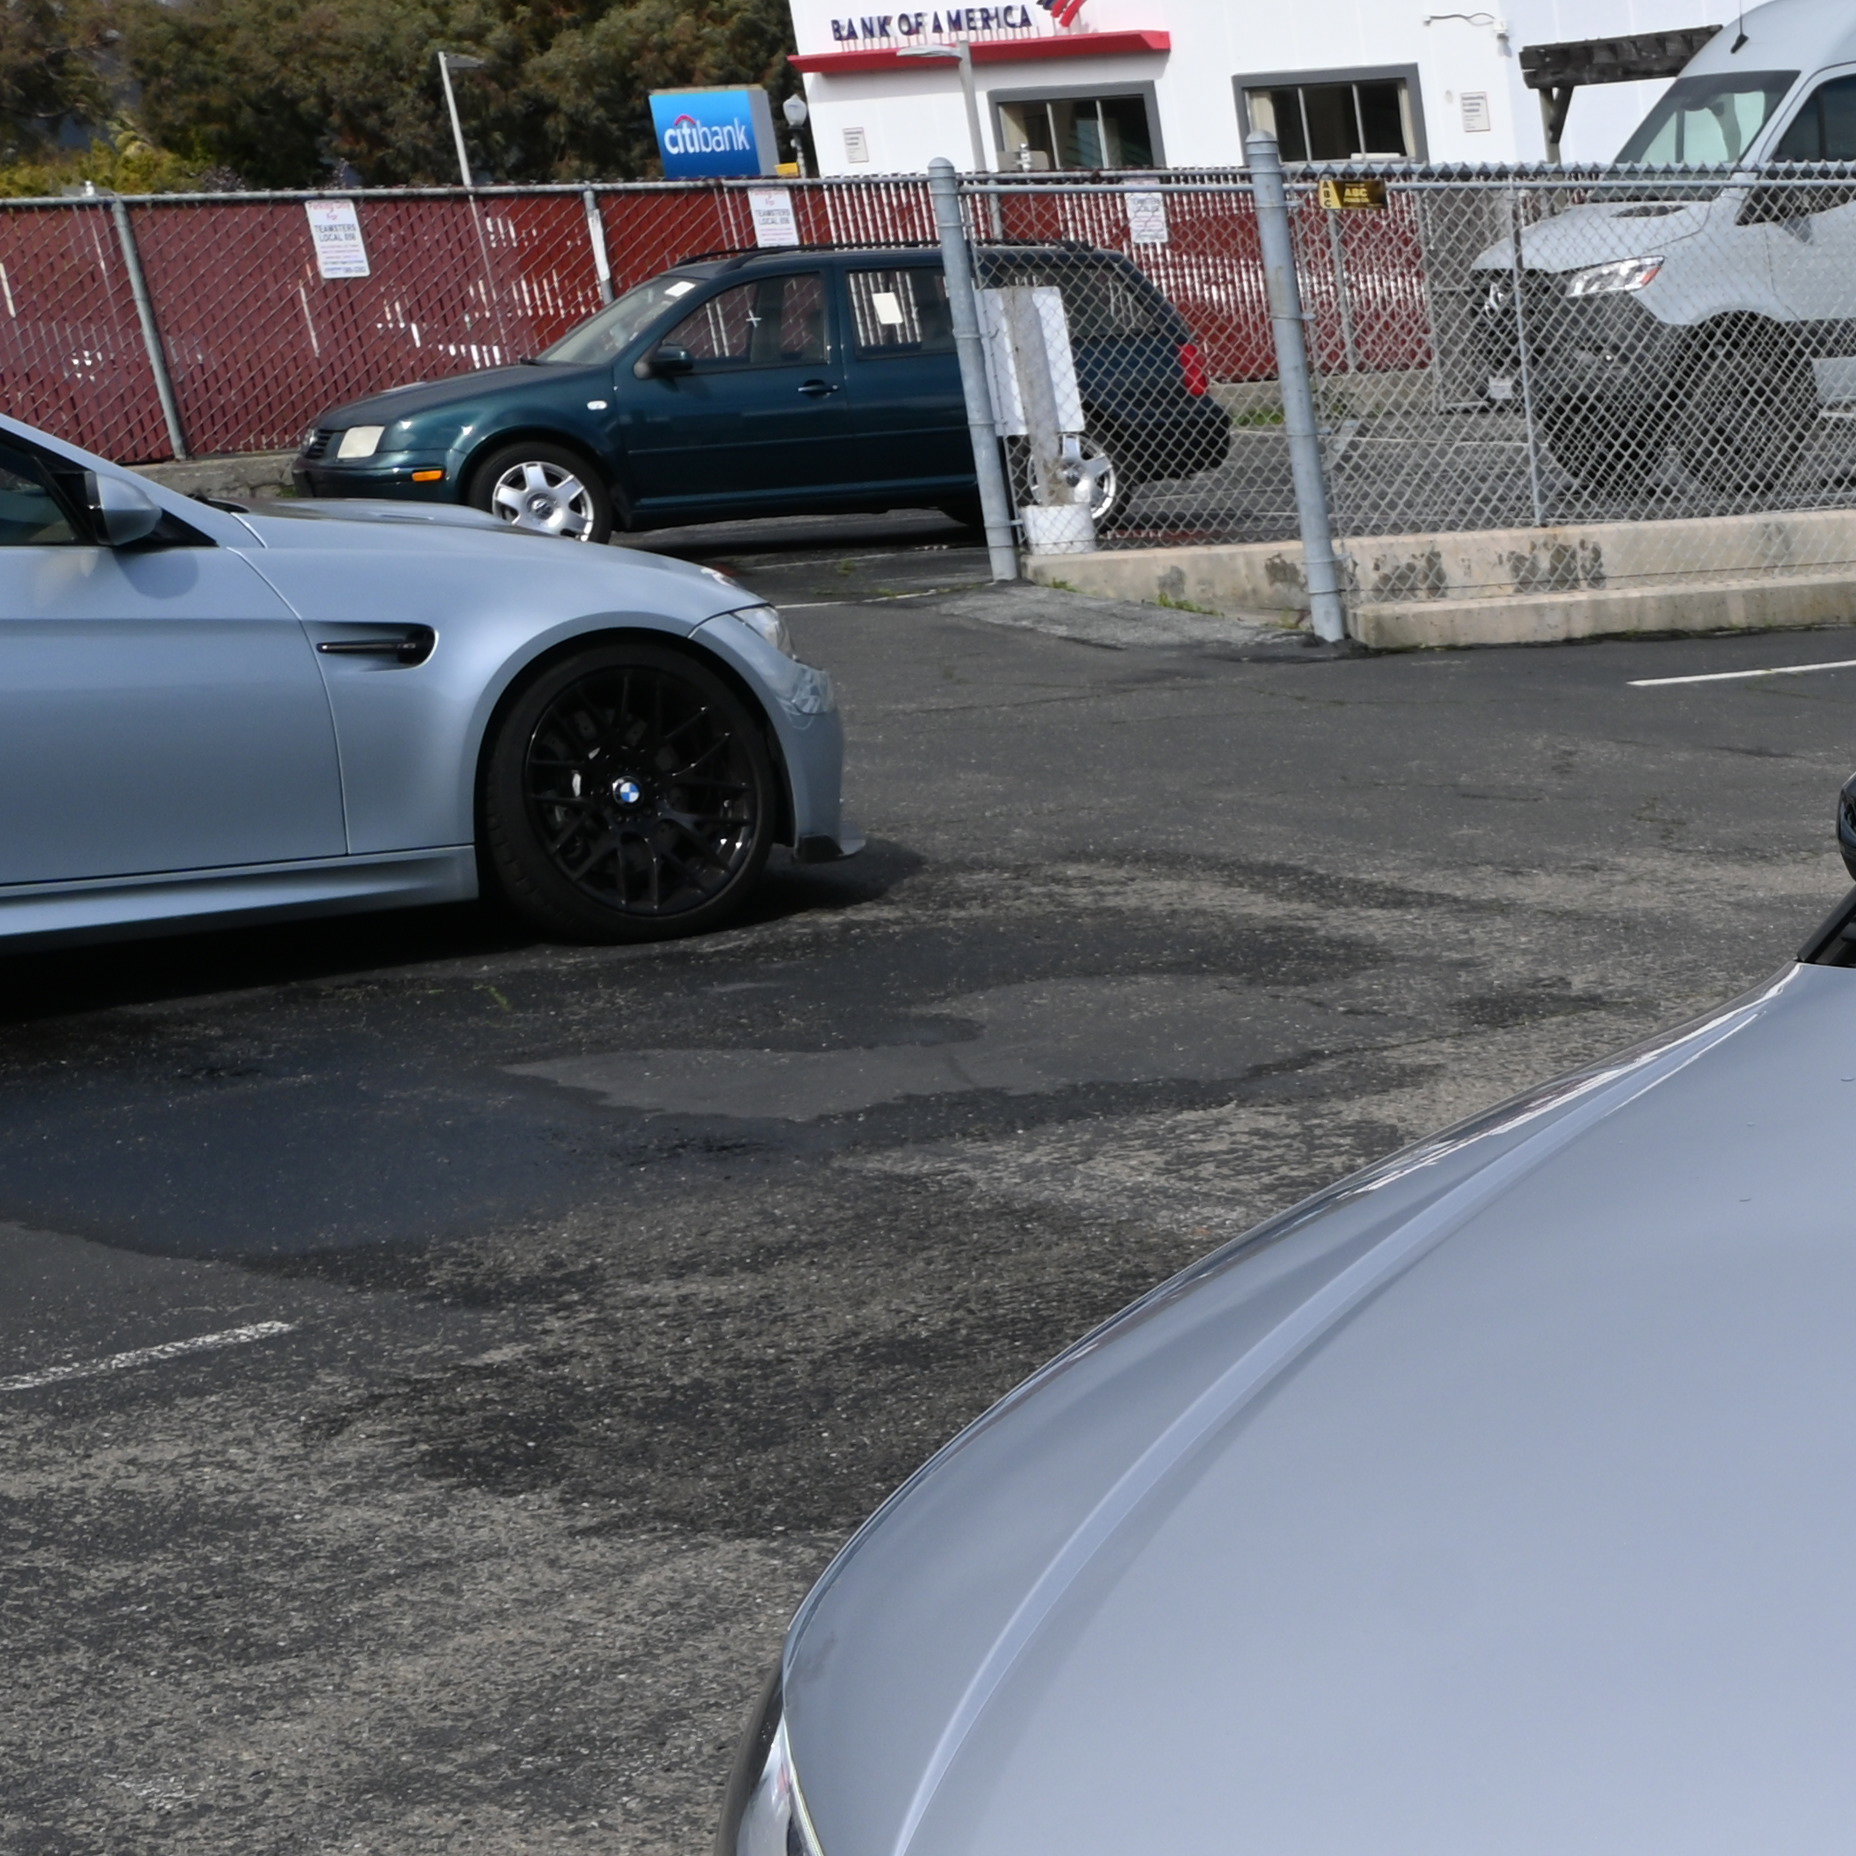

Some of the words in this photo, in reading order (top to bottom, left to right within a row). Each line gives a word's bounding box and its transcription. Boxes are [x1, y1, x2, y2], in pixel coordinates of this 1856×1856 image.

[831, 15, 892, 41] BANK
[898, 12, 927, 36] OF
[931, 4, 1033, 34] AMERICA
[664, 115, 750, 154] citibank
[313, 223, 357, 233] TEAMSTERS
[319, 233, 343, 242] LOCAL
